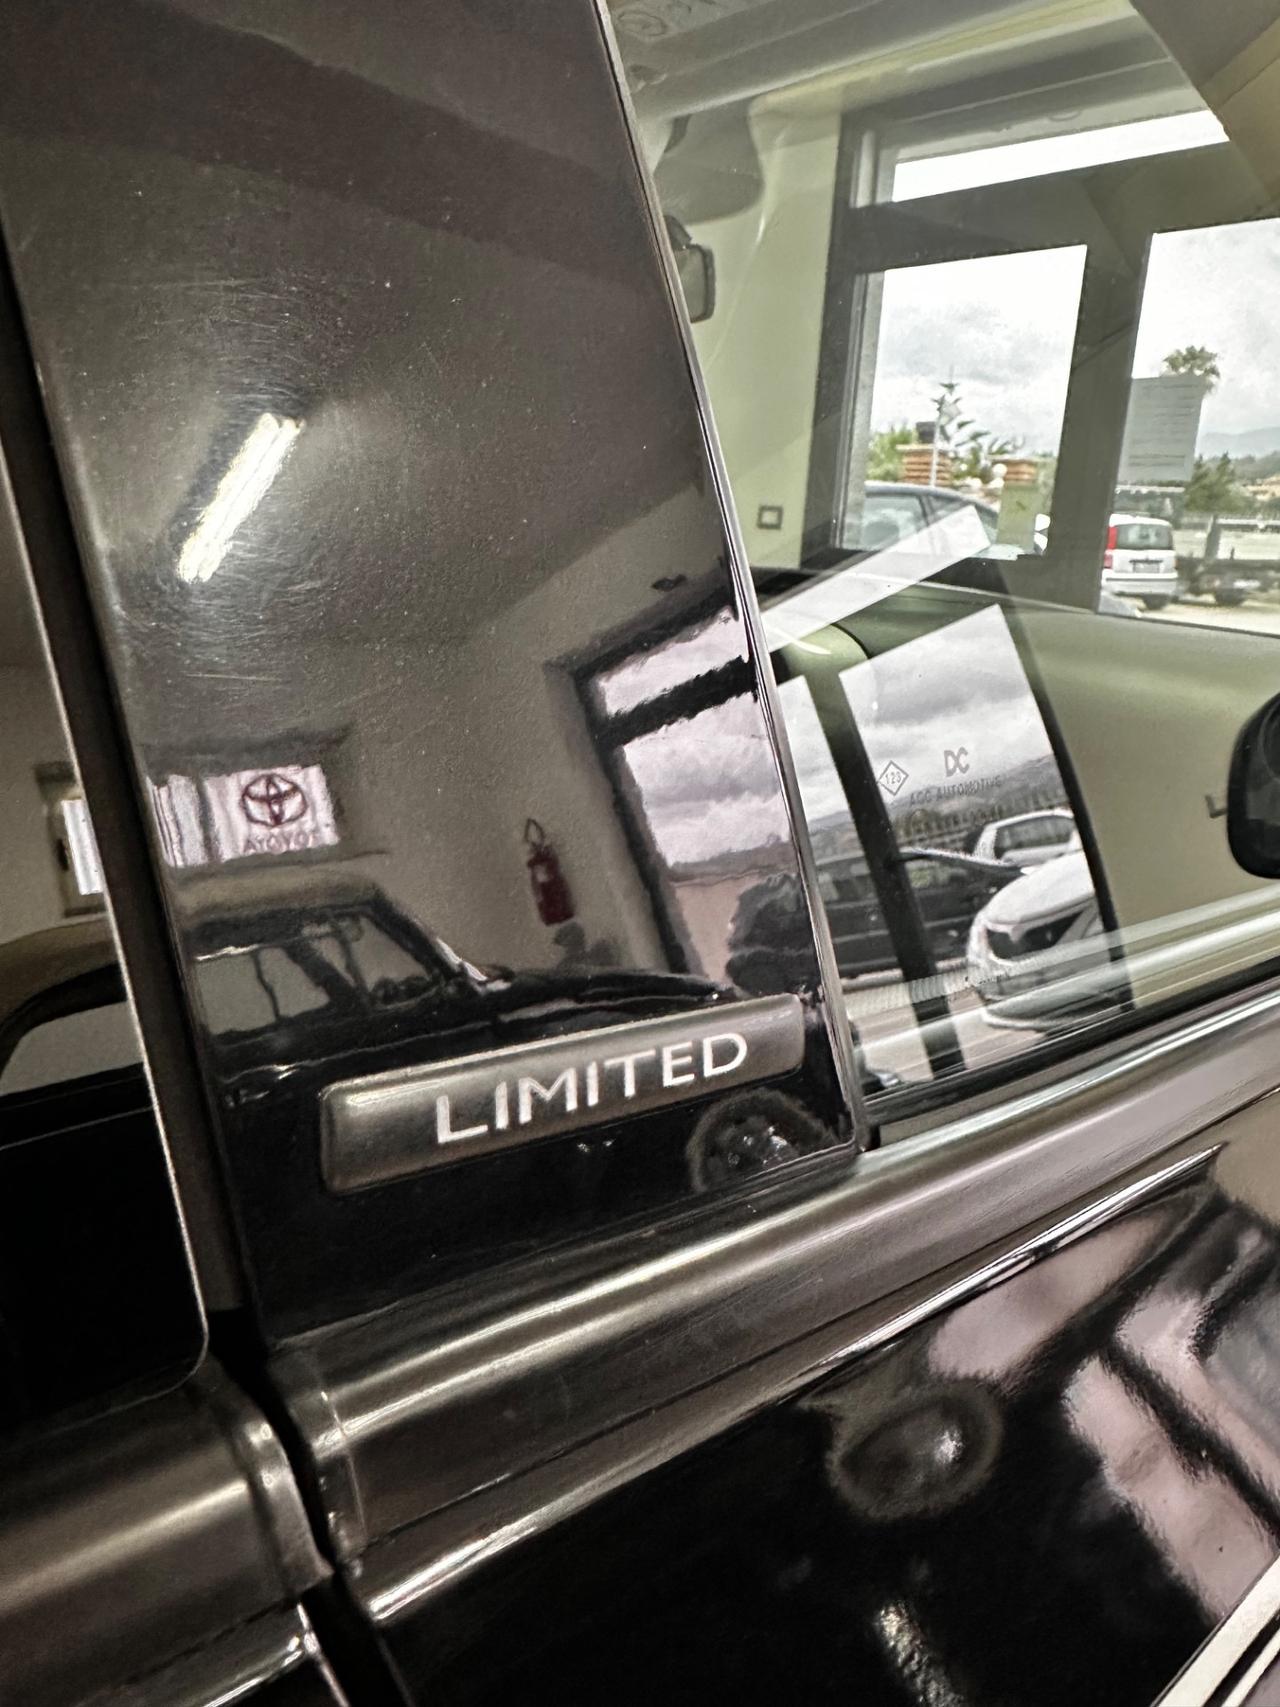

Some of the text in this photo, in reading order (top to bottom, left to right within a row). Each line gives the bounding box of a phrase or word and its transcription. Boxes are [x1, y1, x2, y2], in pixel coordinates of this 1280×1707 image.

[943, 746, 970, 777] DC
[936, 775, 1003, 802] AUTOMOTIVE
[436, 1032, 748, 1144] LIMITED
